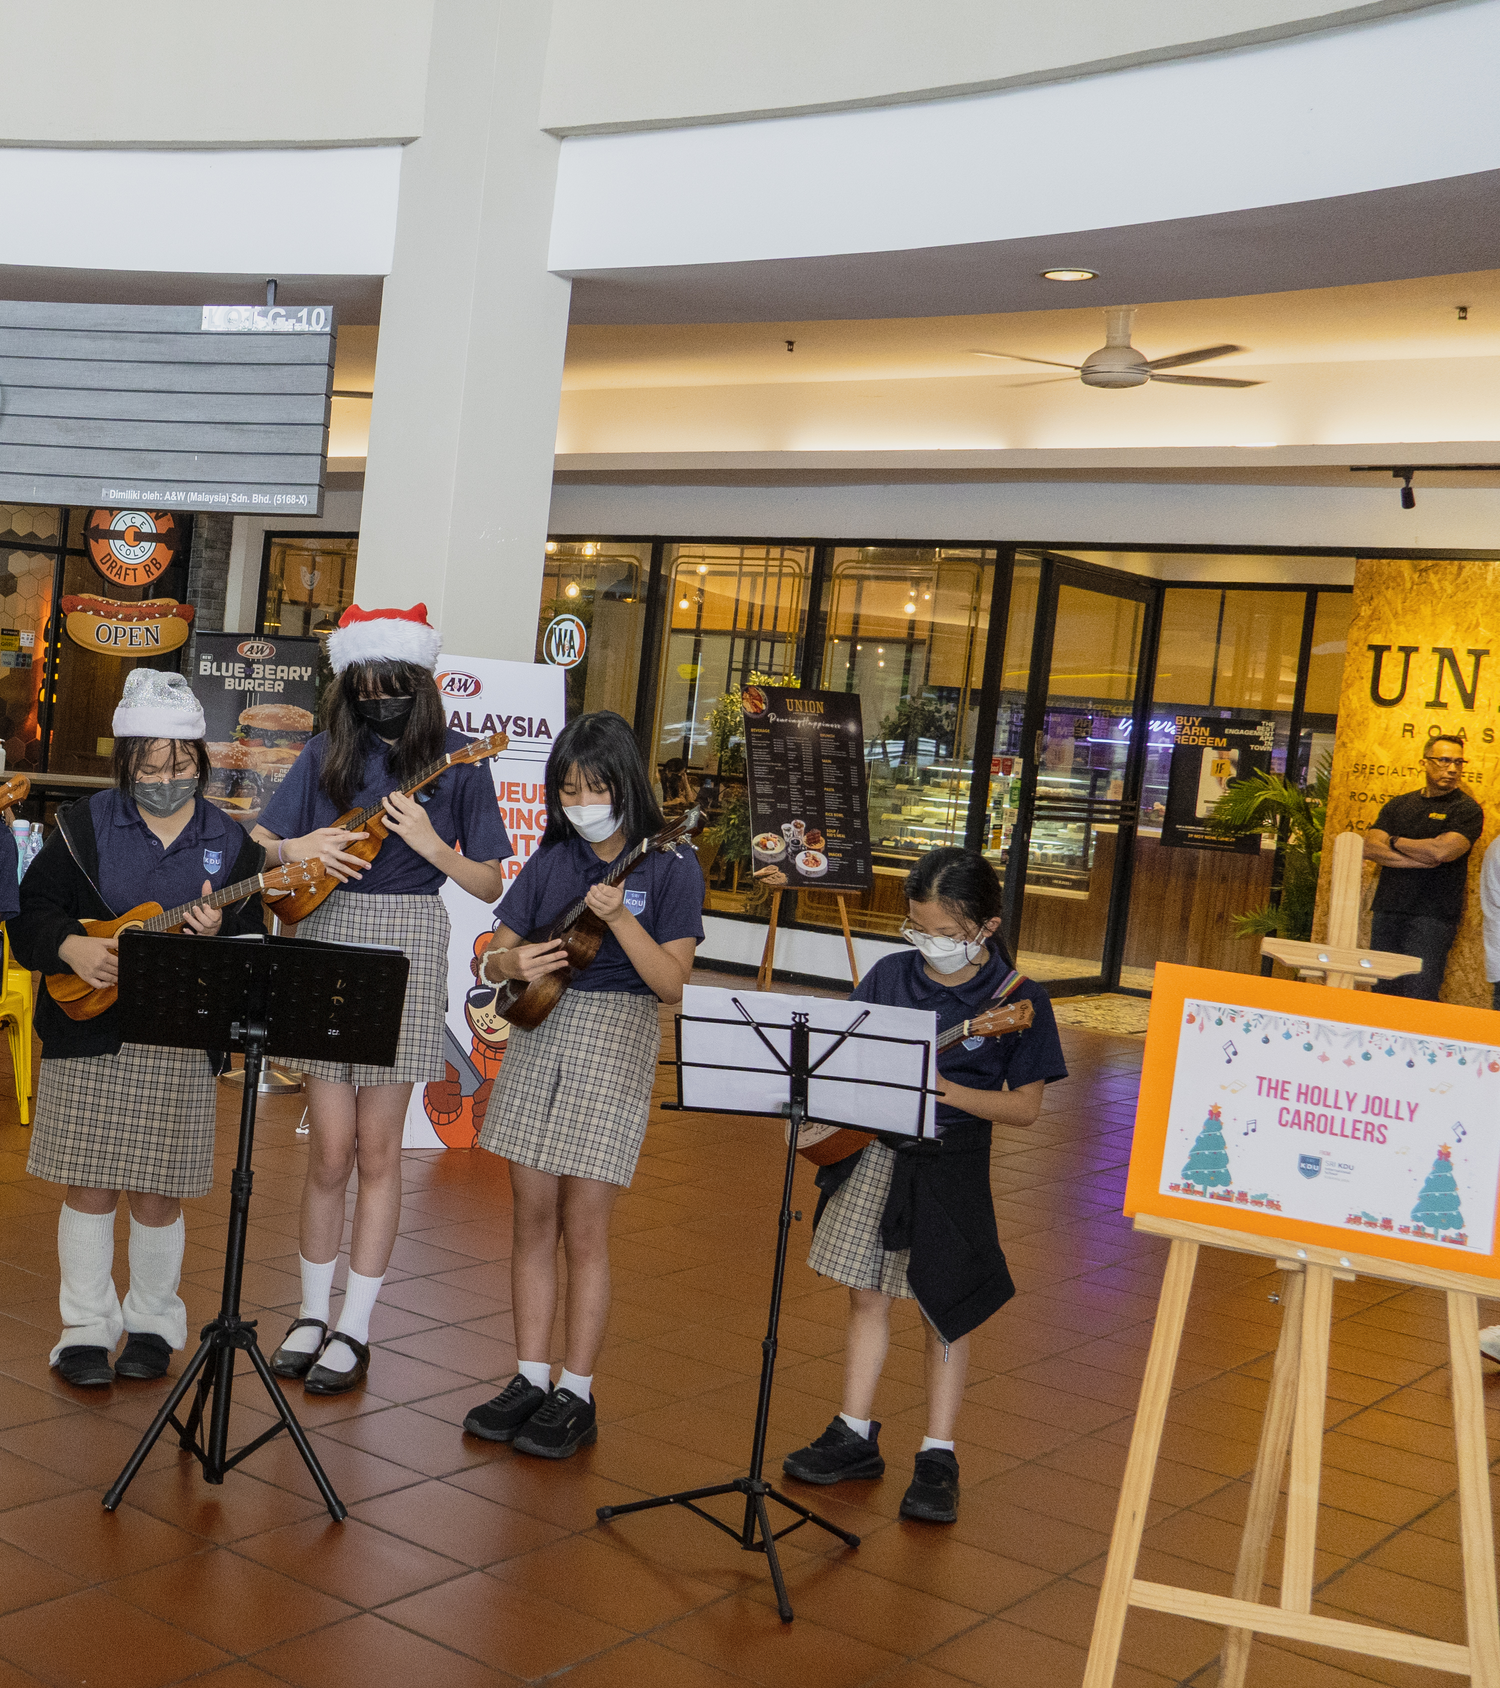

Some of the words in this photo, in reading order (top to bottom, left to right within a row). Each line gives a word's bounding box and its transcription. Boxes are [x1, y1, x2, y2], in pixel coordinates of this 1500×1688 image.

[207, 307, 260, 330] LOT
[267, 307, 326, 330] G-10
[109, 489, 140, 500] Dimiliki
[142, 490, 162, 501] oleh:
[164, 491, 185, 501] A&W
[187, 491, 229, 504] (Malaysia)
[231, 493, 250, 503] Sdn.
[252, 494, 271, 504] Bhd.
[273, 494, 308, 506] (5168-X)
[122, 516, 146, 530] ICE
[118, 543, 146, 557] COLD
[99, 552, 138, 582] DRAFT
[142, 557, 162, 579] RB
[95, 622, 161, 647] OPEN
[199, 661, 245, 677] BLUE
[252, 664, 312, 681] BEARY
[1367, 643, 1500, 713] UN
[224, 677, 285, 693] BURGER
[443, 676, 474, 693] A&W
[786, 698, 825, 714] UNION
[448, 710, 553, 739] ALAYSIA
[1175, 715, 1202, 726] BUY
[1175, 725, 1210, 737] EARN
[1224, 728, 1275, 737] ENGAGEMENT
[1402, 722, 1496, 744] ROAS
[1173, 735, 1228, 747] REDEEM
[1352, 762, 1423, 778] SPECIALTY
[625, 899, 644, 907] KDU
[1255, 1075, 1292, 1101] THE
[1296, 1083, 1358, 1113] HOLLY
[1361, 1094, 1419, 1123] JOLLY
[1277, 1106, 1389, 1145] CAROLLERS
[1300, 1162, 1320, 1171] KDU
[1338, 1162, 1355, 1171] KDU
